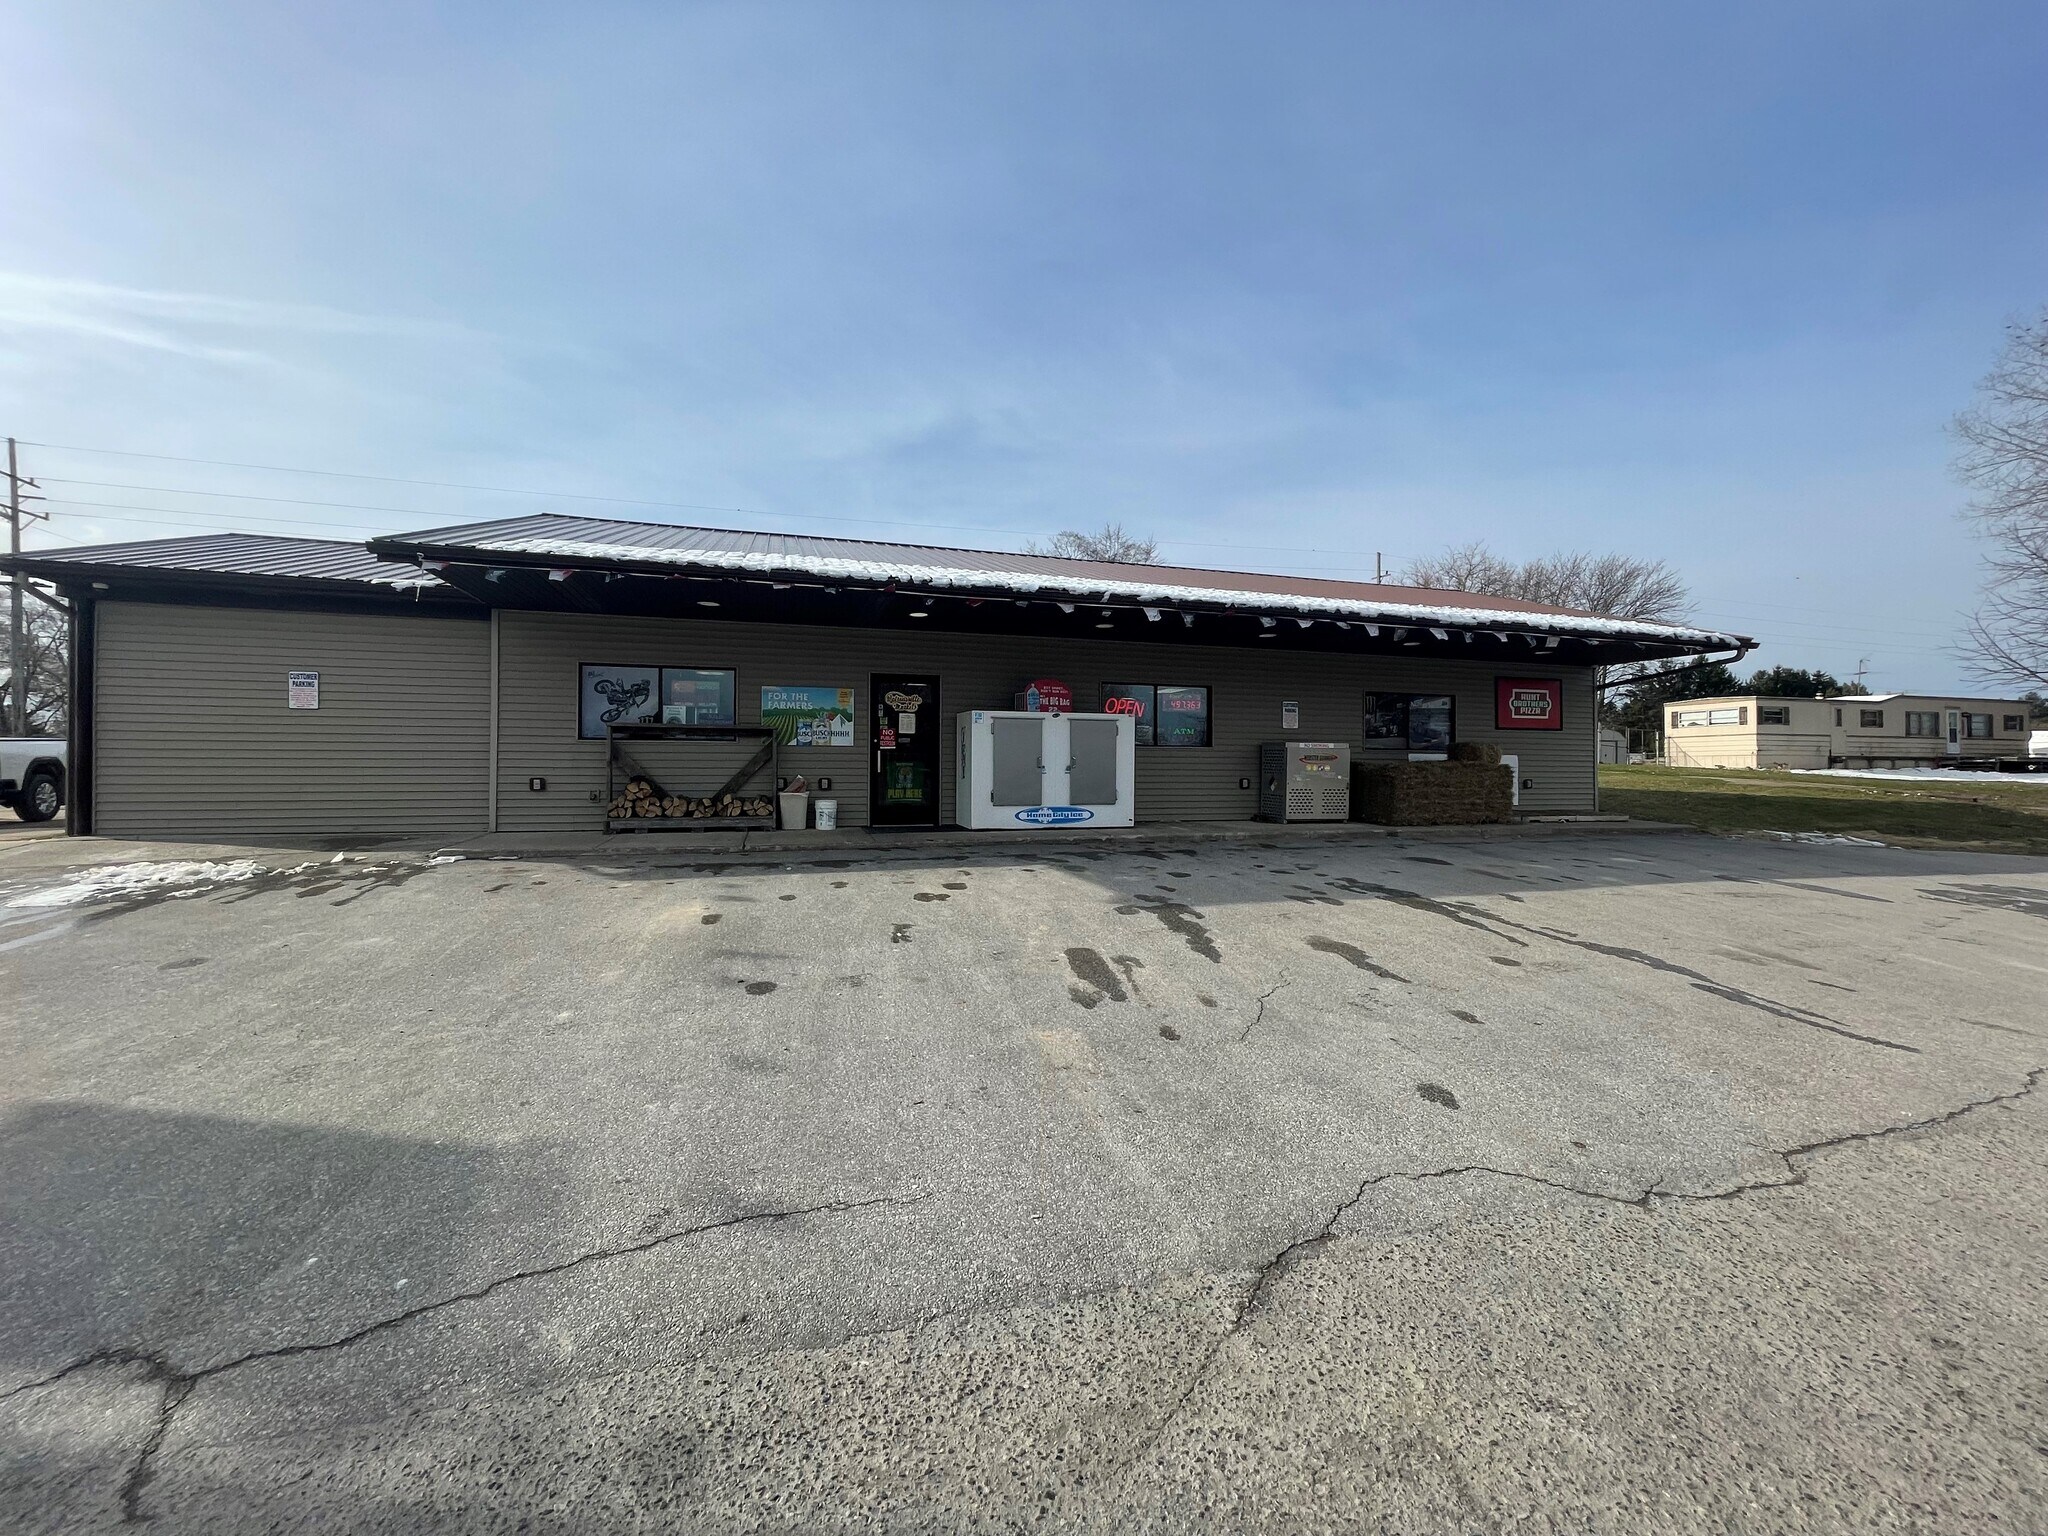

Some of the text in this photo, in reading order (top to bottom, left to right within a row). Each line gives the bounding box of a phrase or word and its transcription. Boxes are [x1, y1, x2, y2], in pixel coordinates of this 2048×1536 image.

[768, 692, 809, 701] FOR THE
[1040, 697, 1049, 705] THE
[1050, 696, 1059, 706] BIG
[1059, 697, 1070, 706] BAG
[768, 701, 813, 710] FARMERS
[1104, 697, 1146, 718] OPEN
[1513, 700, 1548, 708] BROTHERS
[887, 788, 923, 799] PLAY HERE
